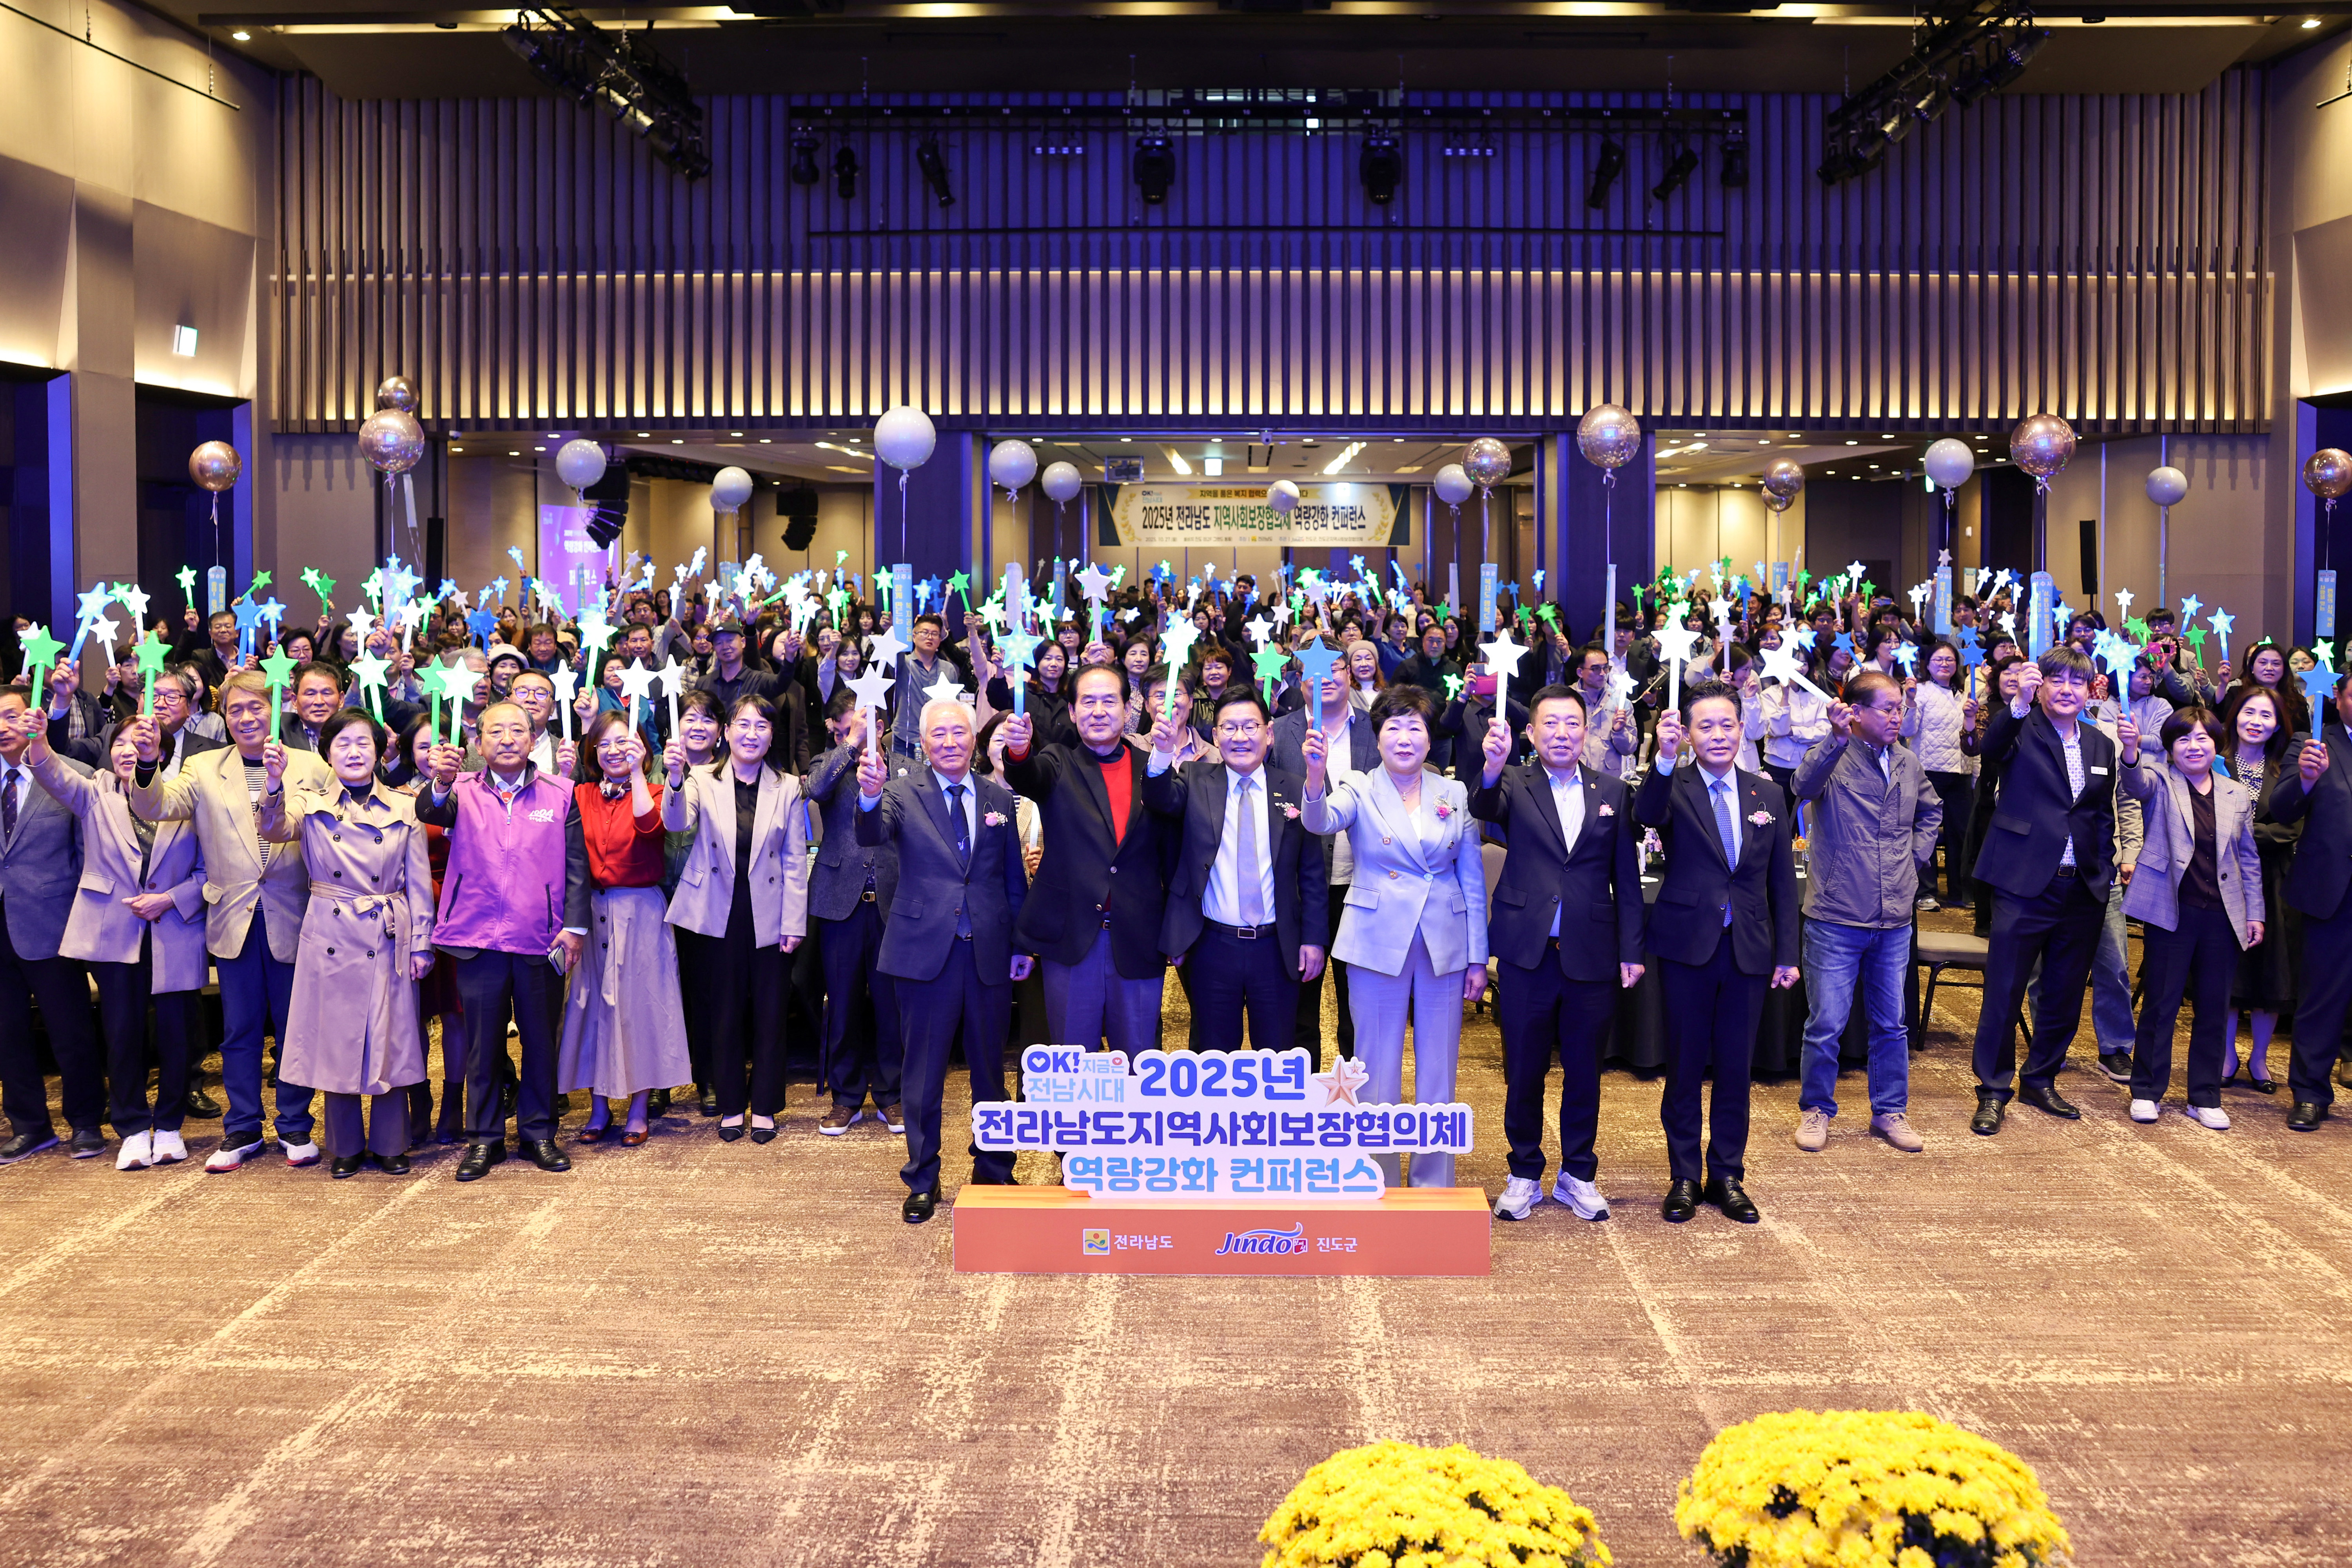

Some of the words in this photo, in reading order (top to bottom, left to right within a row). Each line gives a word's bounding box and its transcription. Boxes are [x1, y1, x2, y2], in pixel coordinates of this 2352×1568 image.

[1200, 490, 1218, 498] 지역을
[1234, 490, 1247, 498] 복지
[1142, 505, 1173, 531] 2025년
[1176, 505, 1211, 531] 전라남도
[1214, 504, 1291, 531] 지역사회보장협의체
[1294, 505, 1329, 531] 역량강화
[1332, 505, 1367, 530] 컨퍼런스
[569, 569, 597, 586] 퍼먼스
[1027, 1051, 1080, 1073] OK!
[1082, 1057, 1124, 1073] 지금은
[1140, 1056, 1305, 1100] 2025년
[1028, 1077, 1124, 1103] 전남시대
[979, 1109, 1466, 1147] 전라남도지역사회보장협의체
[1069, 1156, 1219, 1192] 역량강화
[1230, 1156, 1378, 1193] 컨퍼런스
[1114, 1234, 1174, 1250] 전라남도
[1215, 1232, 1293, 1255] Jindo
[1316, 1237, 1358, 1252] 진도군
